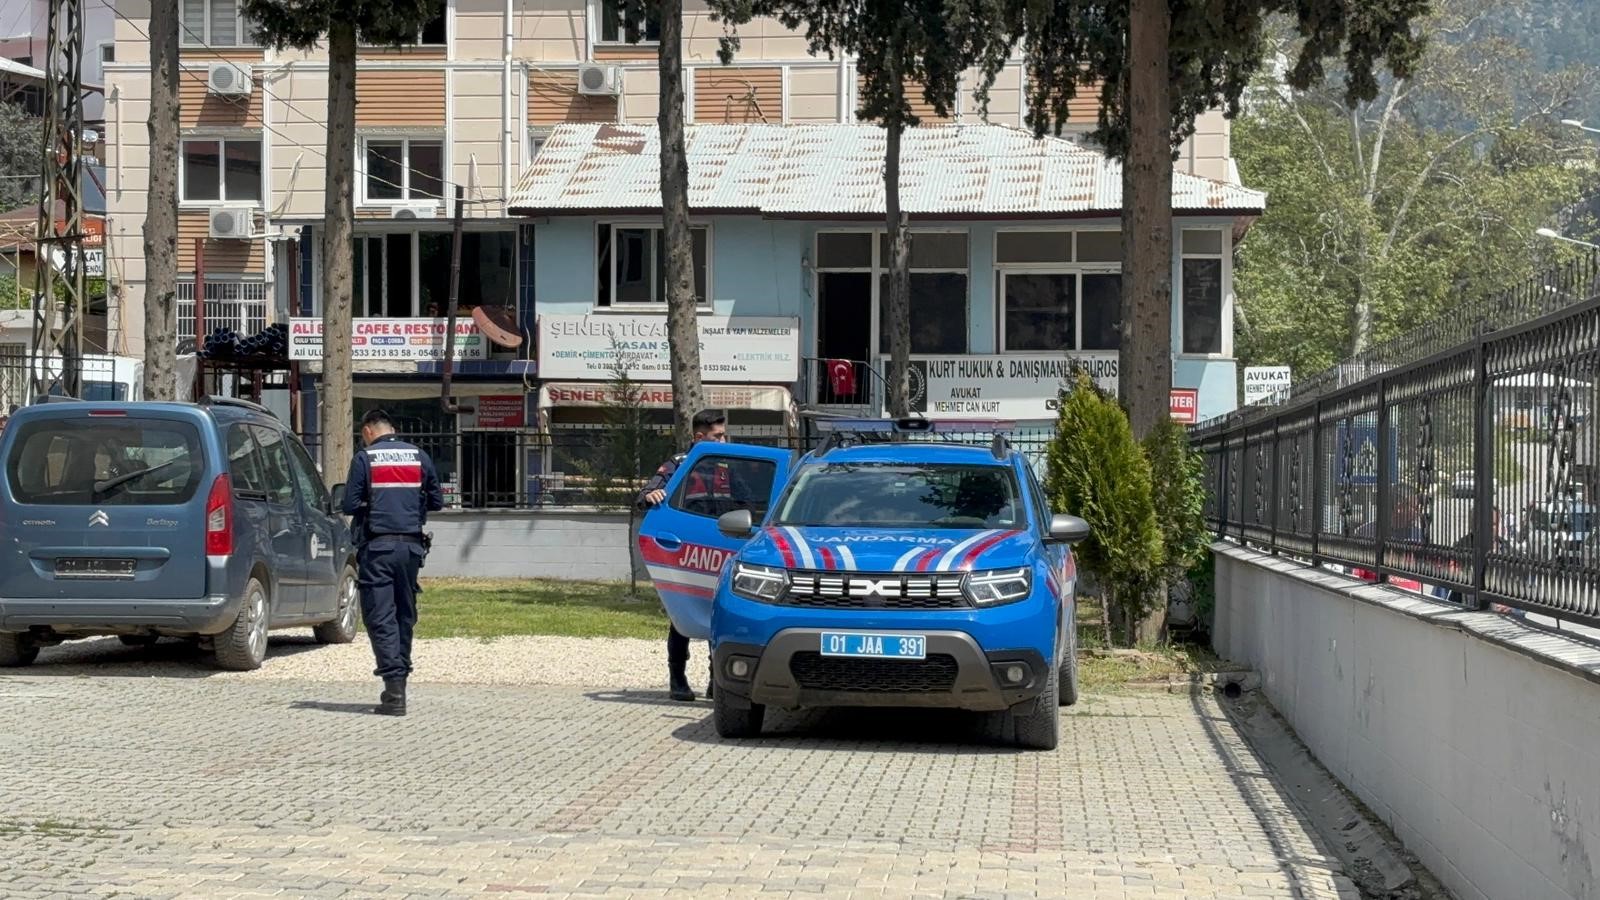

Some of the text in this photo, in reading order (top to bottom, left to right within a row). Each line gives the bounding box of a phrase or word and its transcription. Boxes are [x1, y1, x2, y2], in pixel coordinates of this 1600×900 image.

[293, 320, 314, 334] ALİ
[356, 323, 480, 335] CAFE & RESTOANT
[551, 321, 613, 339] ŞENER
[616, 341, 658, 350] HASAN
[352, 349, 369, 357] 533
[372, 349, 387, 357] 213
[389, 349, 399, 357] 83
[402, 349, 412, 357] 58
[419, 349, 439, 357] 0546
[470, 349, 480, 357] 56
[929, 360, 956, 378] KURT
[958, 360, 994, 378] HUKUK
[996, 360, 1005, 378] &
[1083, 355, 1118, 378] BÜROS
[1247, 371, 1289, 380] AVUKAT
[951, 388, 982, 398] AVUKAT
[934, 402, 1001, 412] MEHMET CAN KURT
[1170, 396, 1194, 408] TER
[808, 535, 956, 545] JANDARMA
[830, 635, 923, 656] 01 JAA 391
